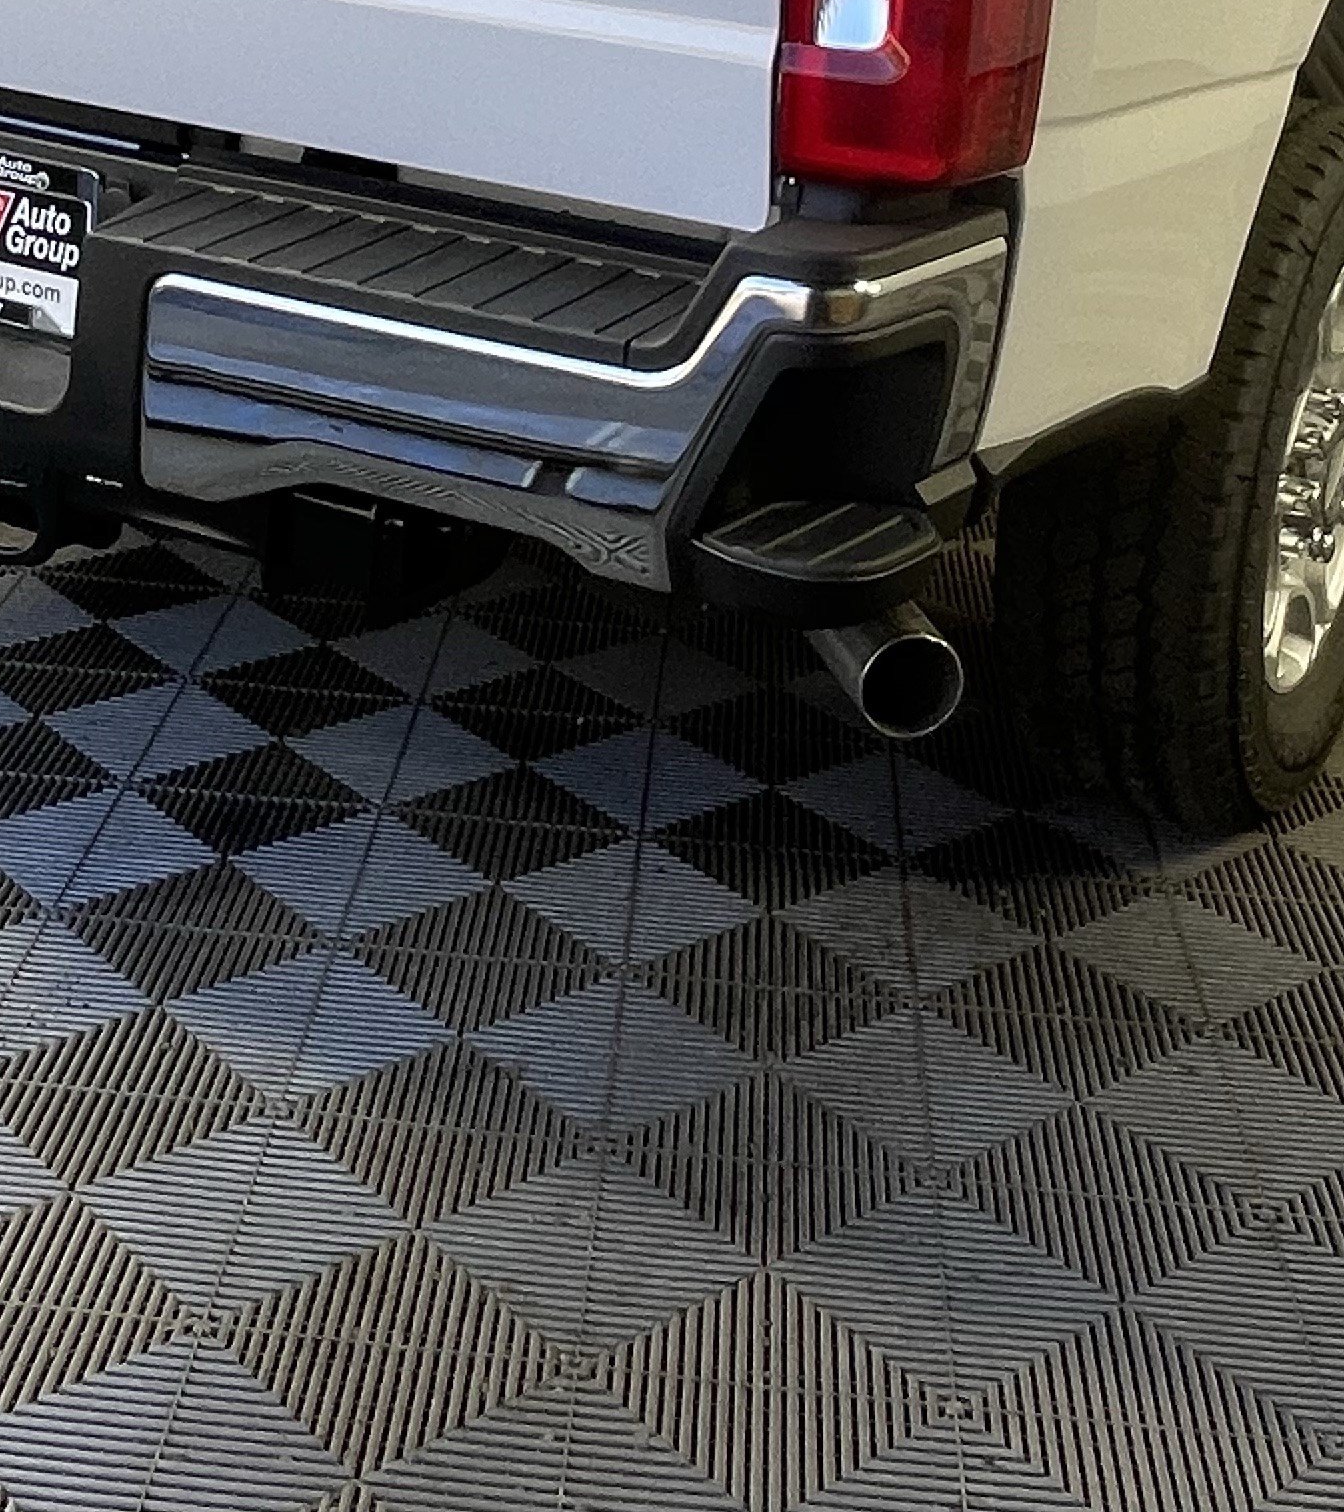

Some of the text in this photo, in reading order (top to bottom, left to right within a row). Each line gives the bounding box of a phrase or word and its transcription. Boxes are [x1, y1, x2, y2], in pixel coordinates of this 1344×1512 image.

[0, 155, 32, 173] Auto
[11, 196, 72, 236] Auto
[5, 224, 80, 270] Group
